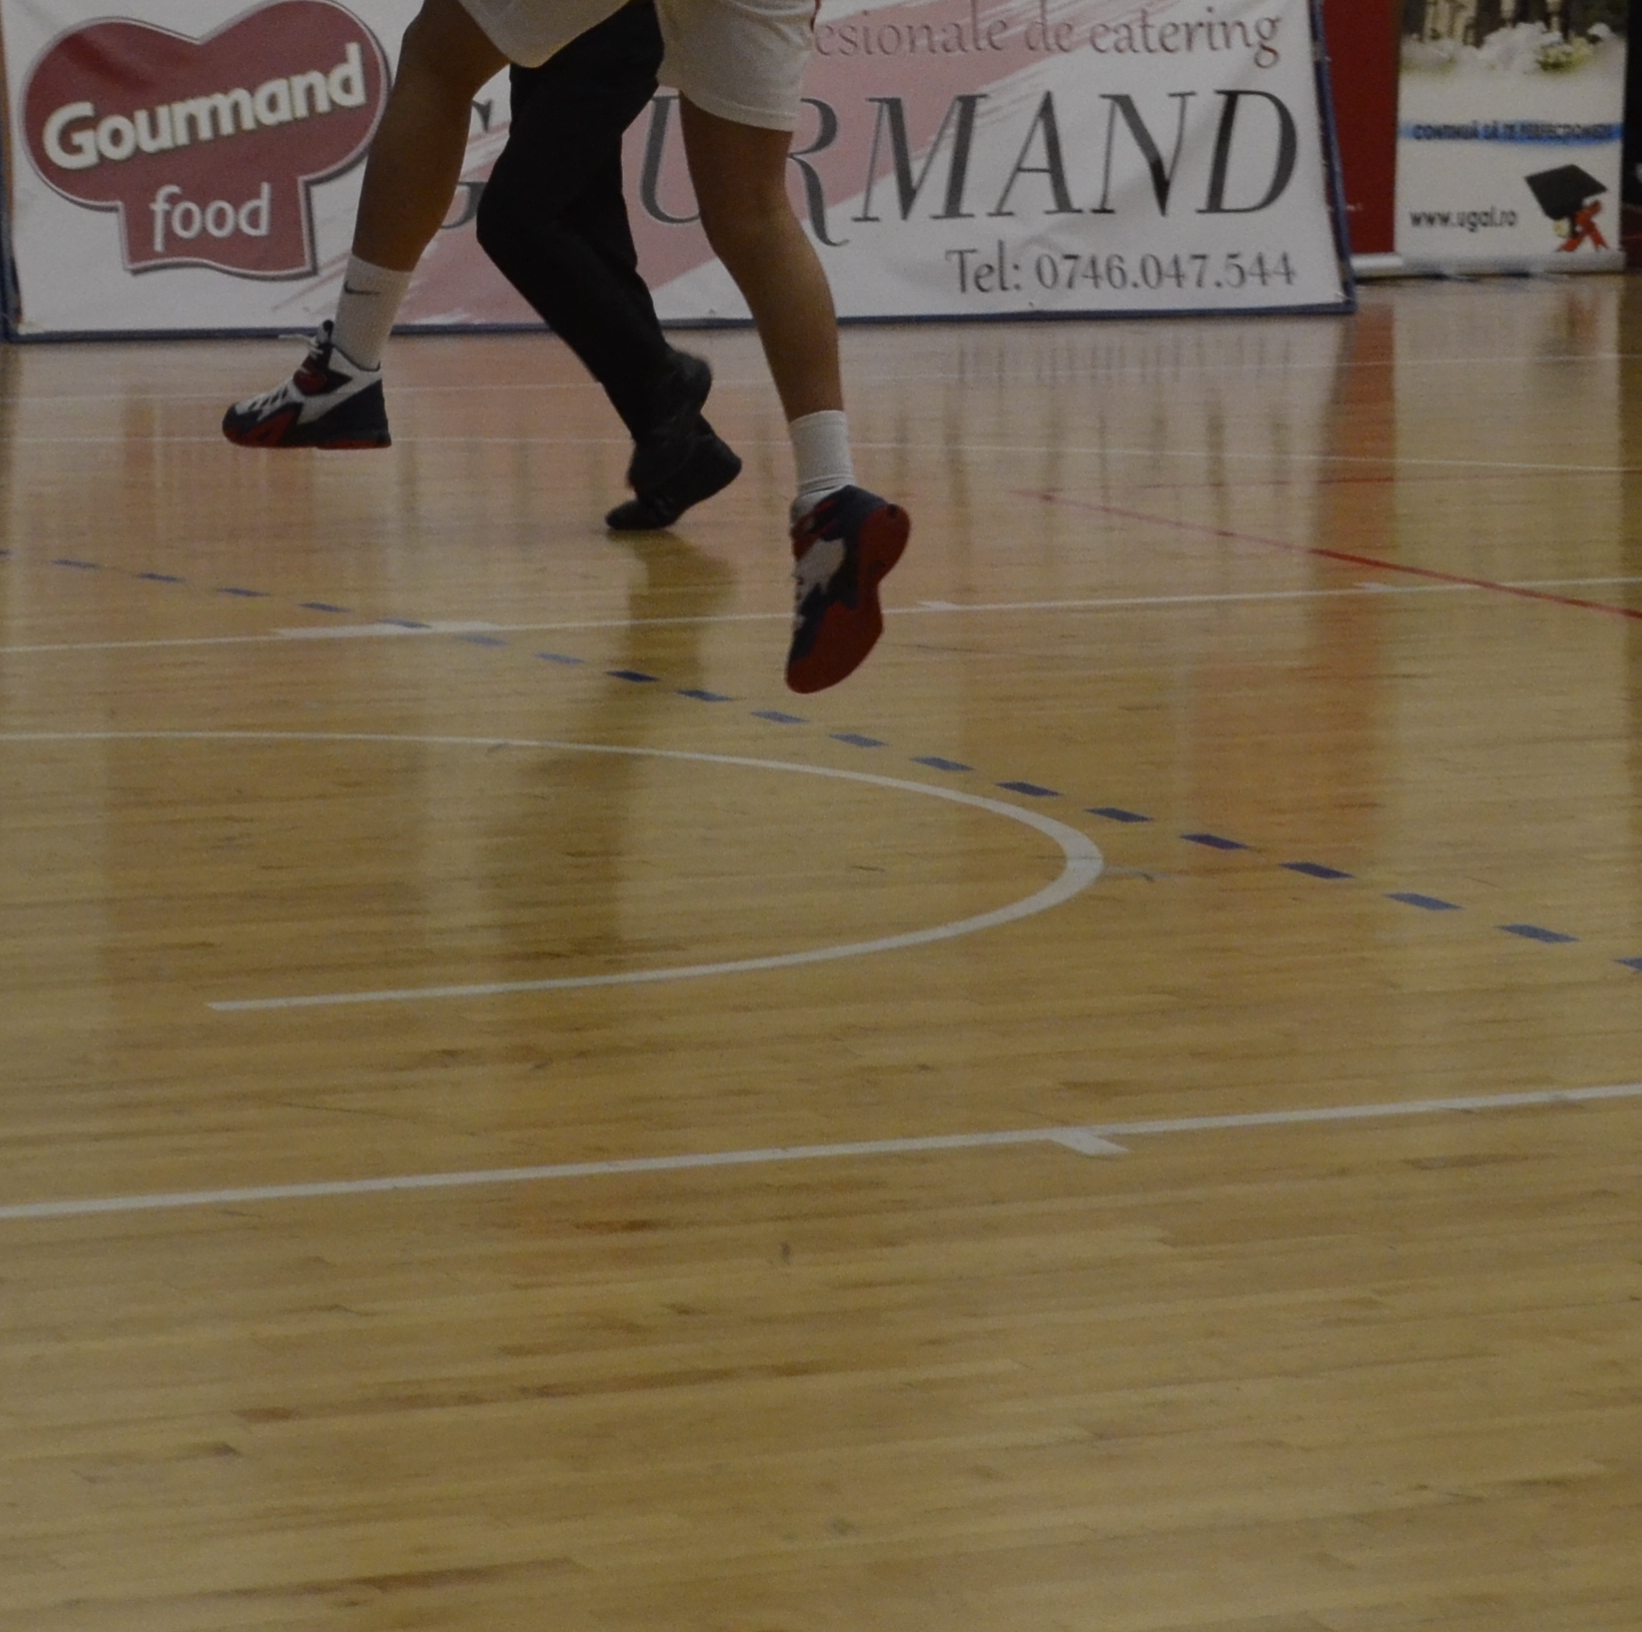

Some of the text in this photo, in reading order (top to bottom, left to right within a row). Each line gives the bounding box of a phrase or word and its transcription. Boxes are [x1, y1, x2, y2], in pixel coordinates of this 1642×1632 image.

[1088, 6, 1284, 68] catering
[42, 41, 369, 171] Gourmand
[440, 89, 1300, 248] URMAND
[150, 182, 271, 253] food
[1410, 205, 1517, 231] www.ugal.ro
[945, 240, 1298, 295] Tel: 0746.047.544
